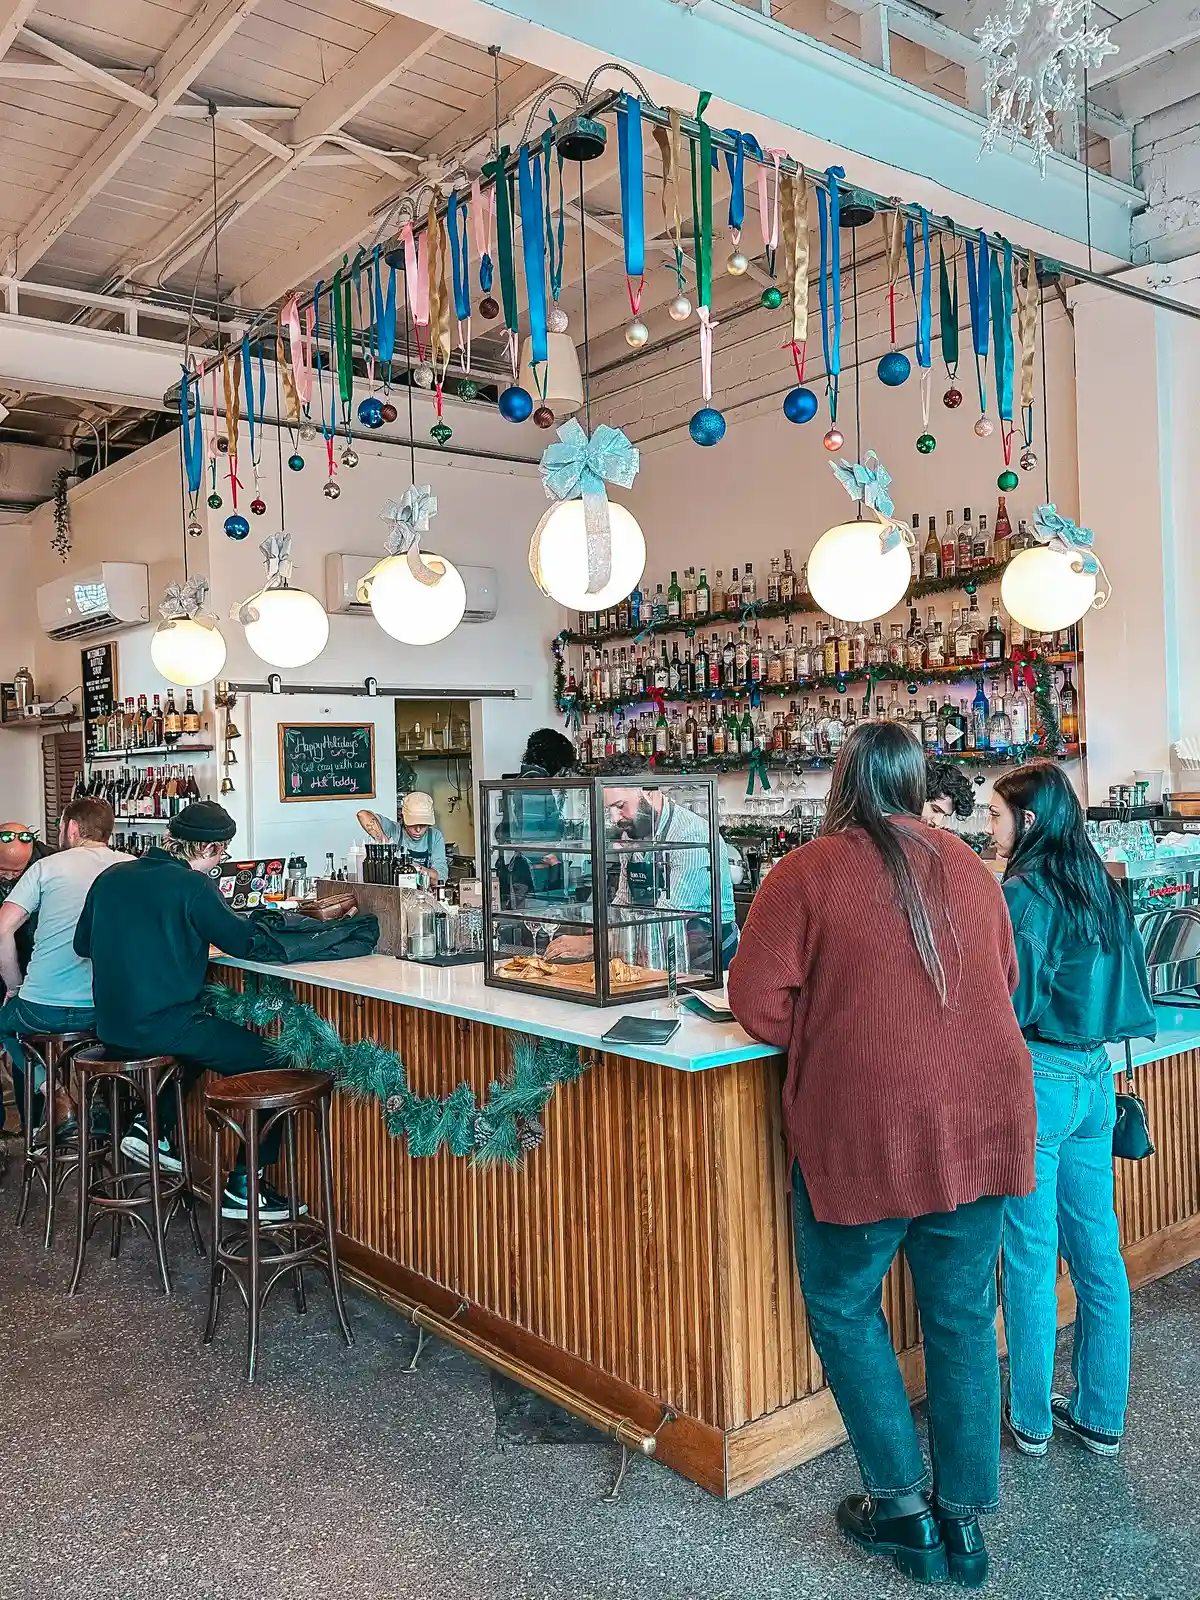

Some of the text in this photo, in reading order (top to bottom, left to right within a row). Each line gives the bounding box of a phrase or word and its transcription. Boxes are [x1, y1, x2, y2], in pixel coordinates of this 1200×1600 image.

[295, 735, 359, 762] Happy Holidays
[301, 758, 367, 779] Get cozy with our
[310, 775, 359, 792] Hot Toddy
